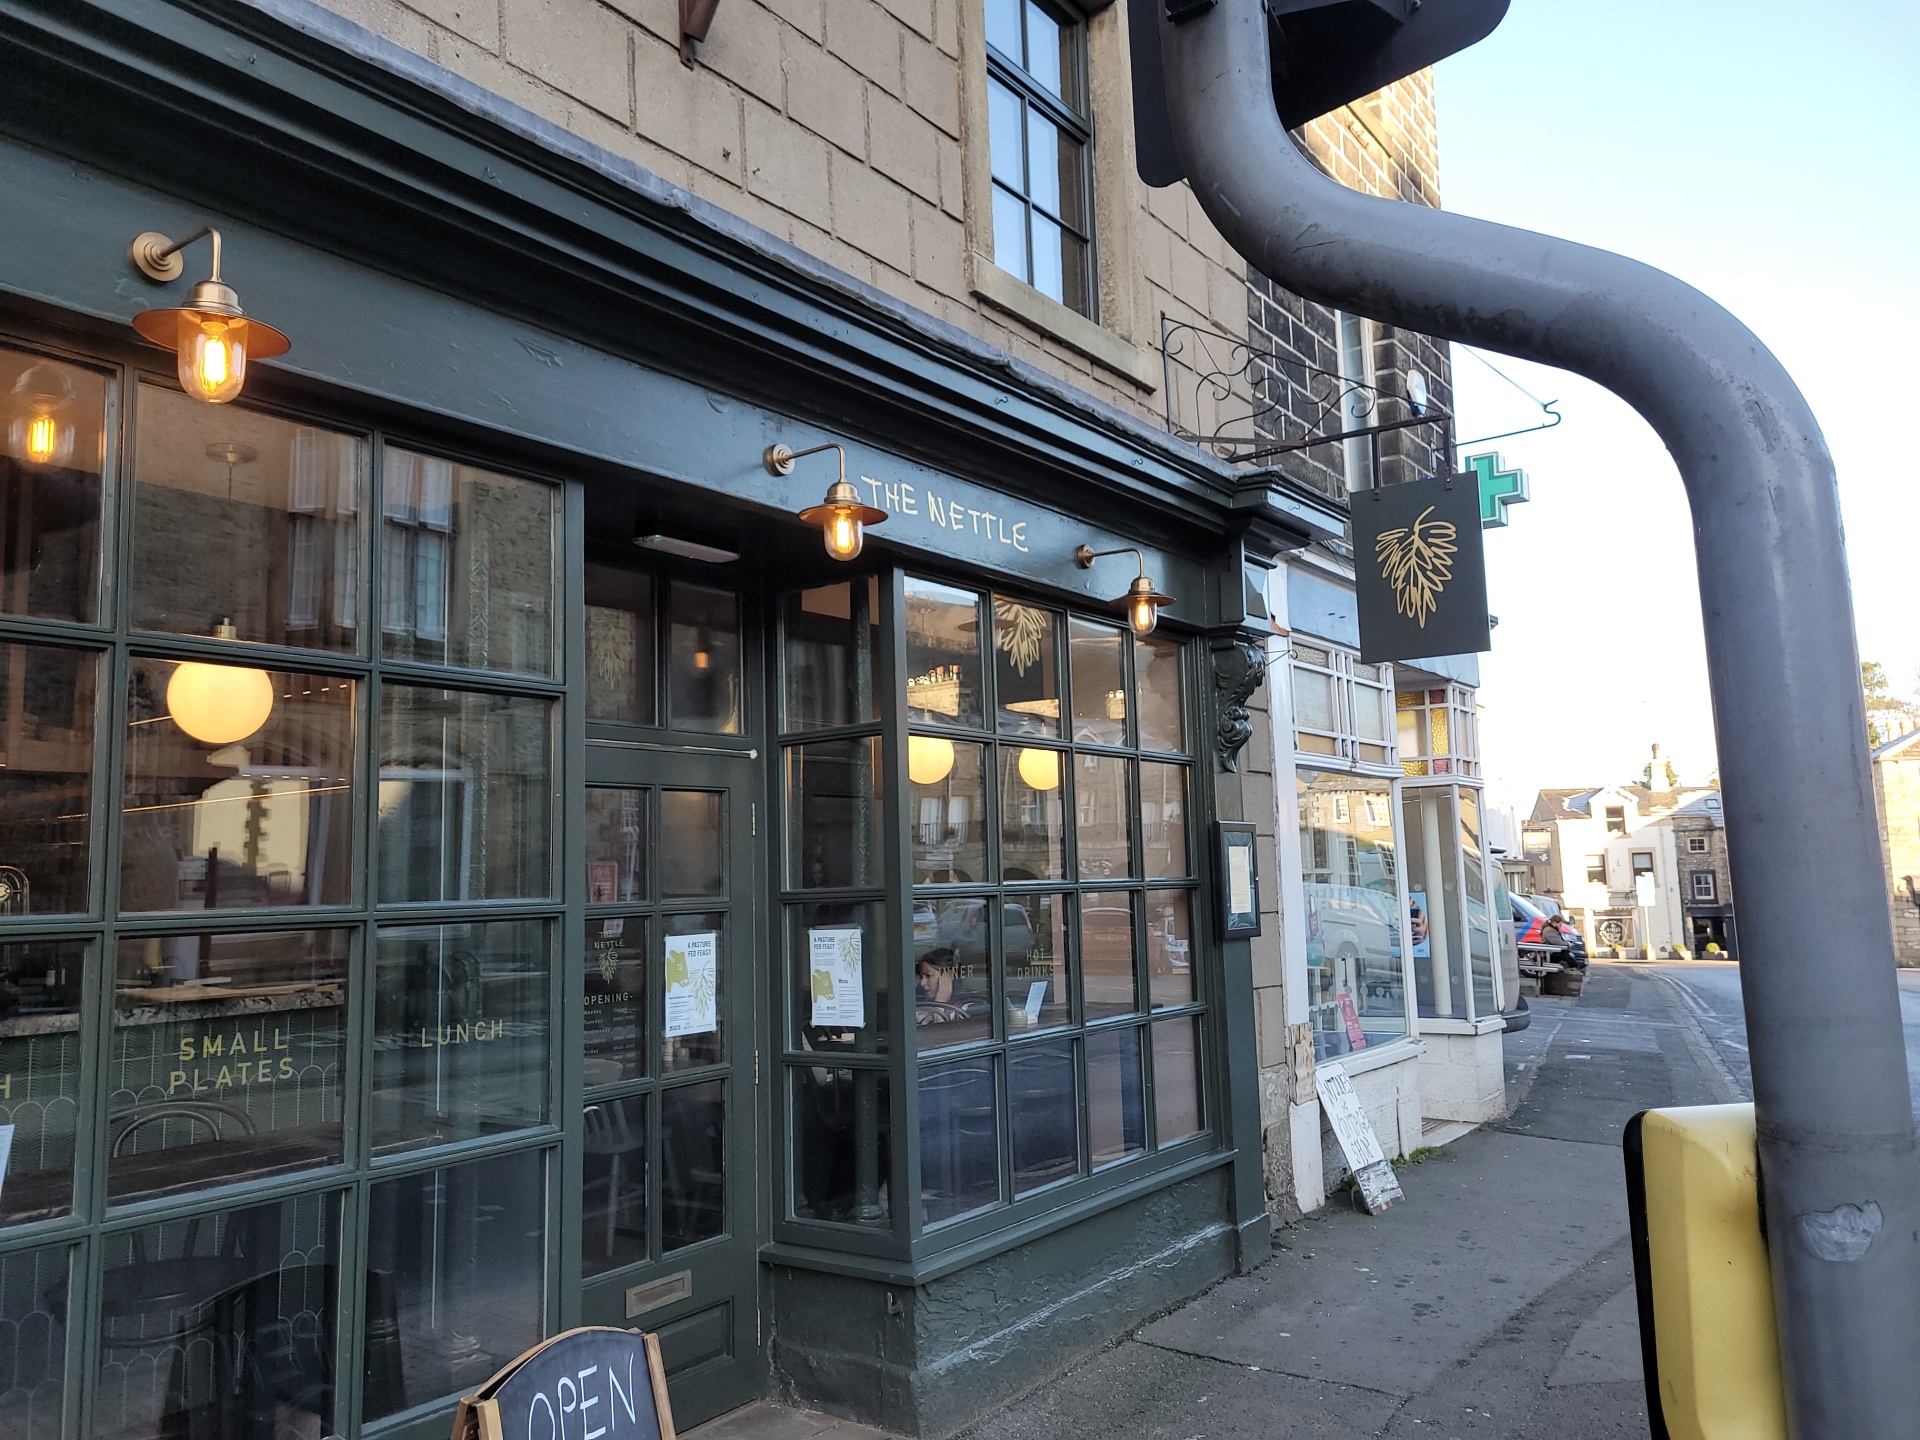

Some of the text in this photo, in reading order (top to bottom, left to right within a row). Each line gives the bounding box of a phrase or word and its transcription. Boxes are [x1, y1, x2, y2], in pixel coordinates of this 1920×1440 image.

[860, 475, 1029, 553] THE NETTLE
[594, 938, 625, 949] NETTLE
[692, 940, 711, 949] PASTURE
[697, 949, 711, 957] FEAST
[1026, 947, 1045, 962] HOT
[1017, 965, 1054, 980] DRINKS
[179, 1028, 288, 1061] SMALL
[421, 1019, 503, 1048] LUNCH
[169, 1057, 294, 1095] PLATES
[528, 1352, 636, 1440] OPEN
